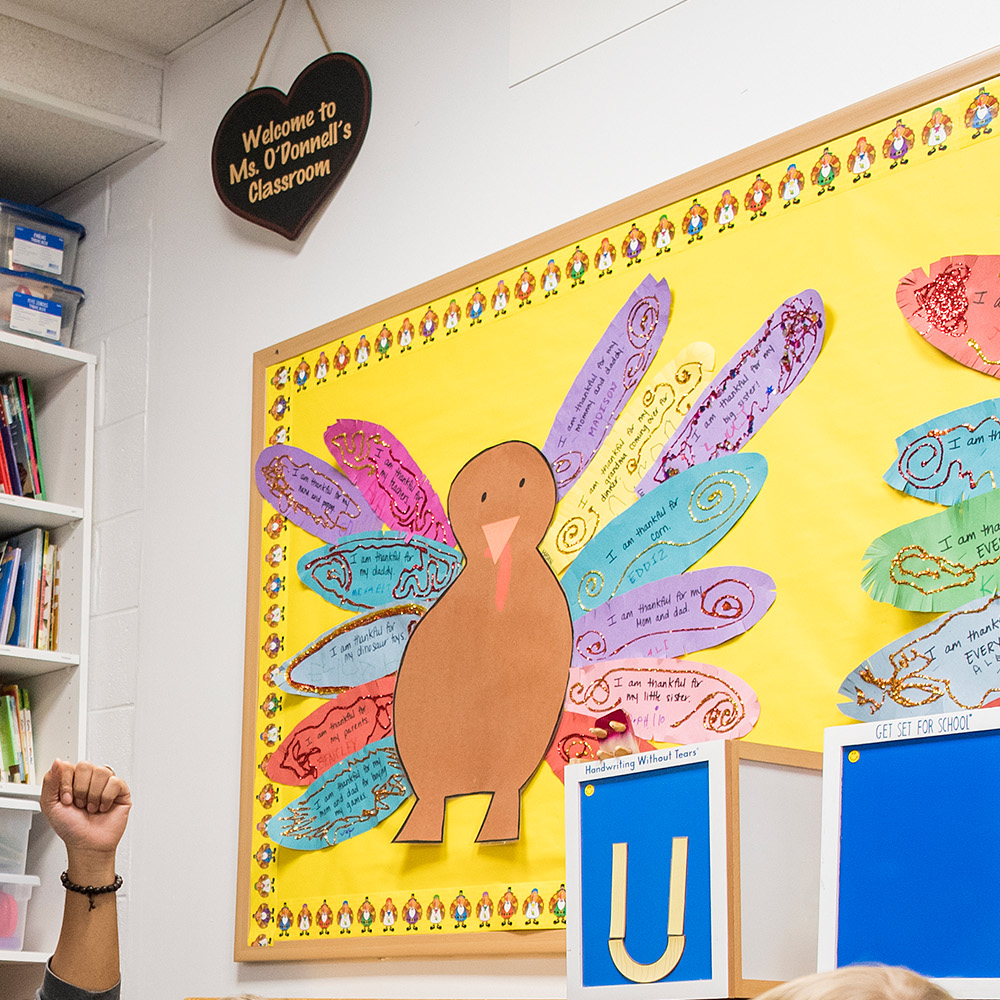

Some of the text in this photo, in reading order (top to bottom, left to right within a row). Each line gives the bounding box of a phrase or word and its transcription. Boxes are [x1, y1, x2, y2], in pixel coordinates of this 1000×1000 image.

[242, 102, 336, 153] Welcome to
[230, 120, 351, 184] Ms. O'Donnell's
[249, 159, 330, 203] Classroom
[973, 291, 987, 304] I
[594, 379, 605, 395] and
[605, 347, 624, 375] daddy.
[557, 341, 618, 448] I am thankful for my
[589, 381, 618, 437] MADISON
[691, 345, 775, 442] I am thankful for my
[723, 381, 761, 424] big sister!
[629, 424, 650, 450] coming
[647, 409, 659, 424] over
[660, 393, 668, 406] for
[948, 435, 984, 450] I am
[578, 410, 649, 508] I am thankful for my
[292, 468, 350, 509] I am thankful for my
[374, 447, 423, 506] I am thankful for
[380, 468, 389, 482] my
[601, 478, 622, 503] dinner.
[311, 493, 321, 505] and
[605, 497, 679, 564] I am thankful for
[650, 525, 672, 542] corn.
[938, 531, 977, 553] I am
[349, 551, 414, 564] I am thankful for
[359, 566, 395, 581] my daddy.
[607, 586, 703, 627] I am thankful for my
[656, 610, 670, 623] and
[673, 604, 690, 618] dad.
[329, 621, 397, 658] I am thankful for
[344, 633, 407, 663] my dinosaur toys.
[924, 639, 962, 661] I am
[613, 677, 704, 688] I am thankful for
[626, 692, 691, 704] my little sister.
[305, 705, 366, 747] I am thankful for
[330, 734, 341, 744] my
[876, 715, 969, 739] GET SET FOR SCHOOL
[585, 749, 696, 775] Handwriting Without Tears
[314, 799, 321, 810] I
[323, 791, 334, 803] am
[337, 770, 361, 791] thankful
[372, 757, 381, 769] my
[318, 807, 331, 818] mom
[333, 797, 344, 807] and
[346, 786, 359, 799] dad
[335, 807, 344, 817] my
